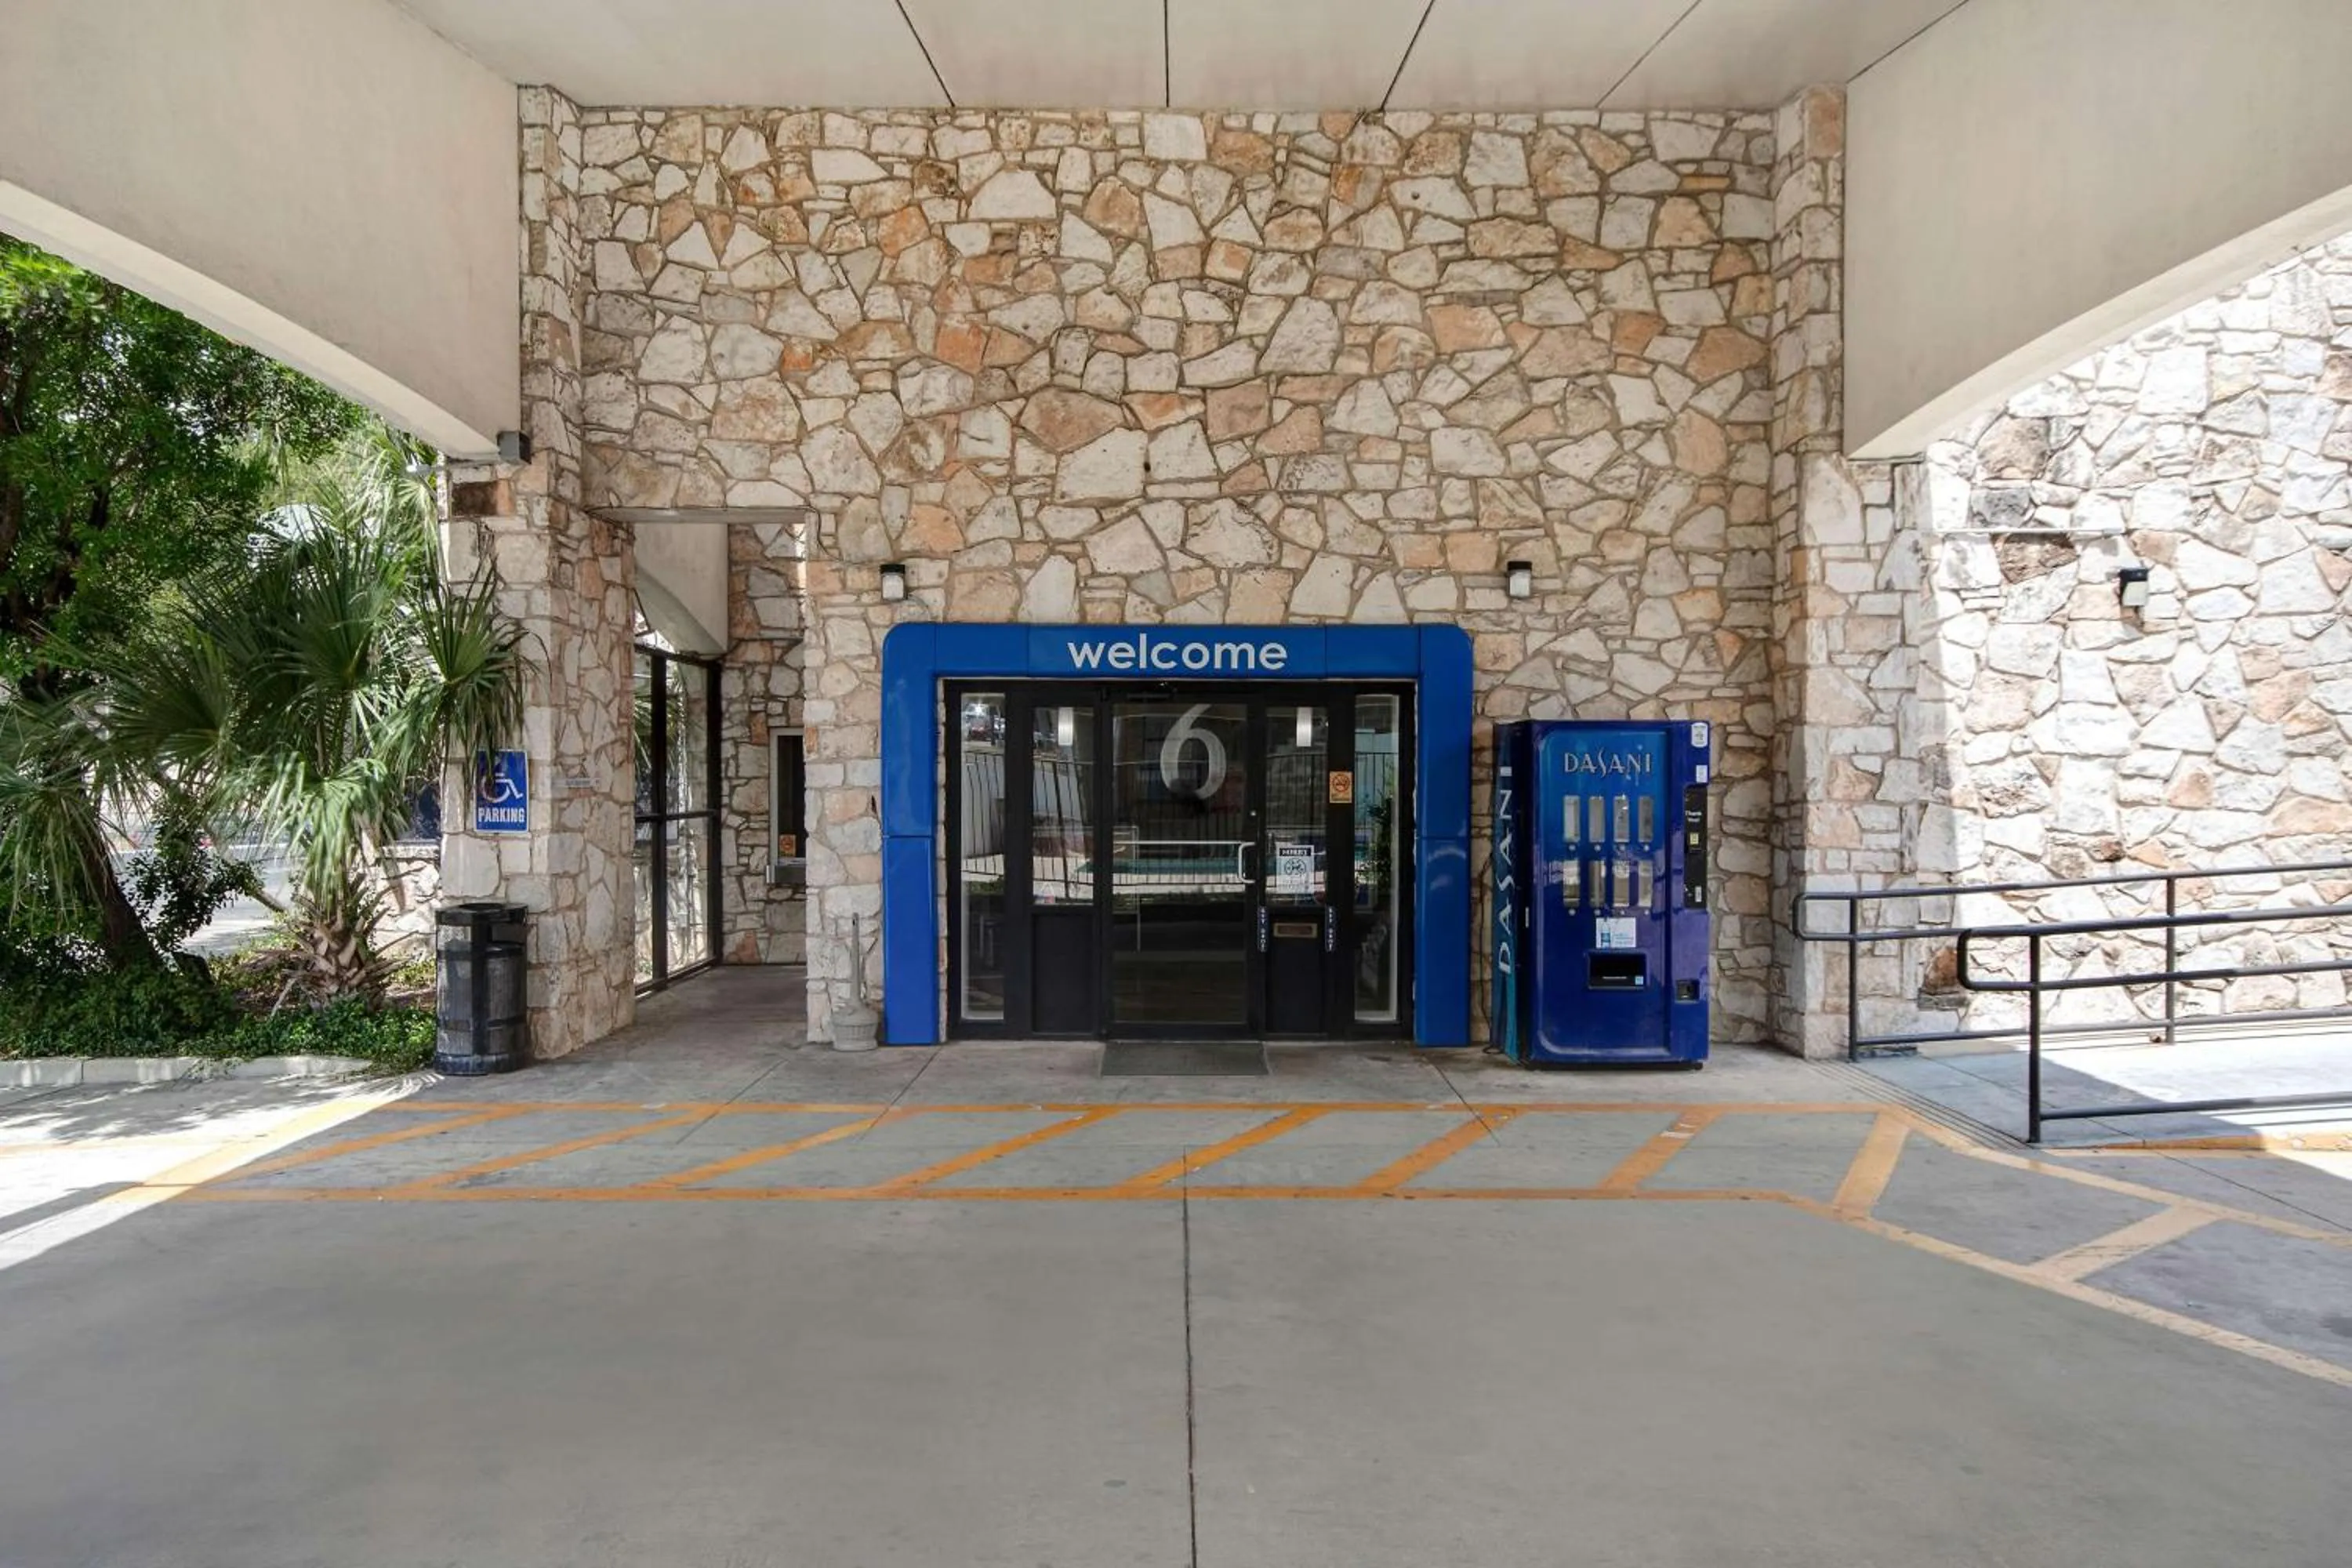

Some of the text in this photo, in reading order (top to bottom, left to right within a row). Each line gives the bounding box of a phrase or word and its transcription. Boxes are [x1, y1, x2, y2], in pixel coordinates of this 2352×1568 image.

[1067, 633, 1288, 670] welcome
[1160, 704, 1226, 800] 6
[1564, 747, 1650, 778] DASANI
[478, 807, 525, 822] PARKING
[1497, 766, 1515, 975] DASANI
